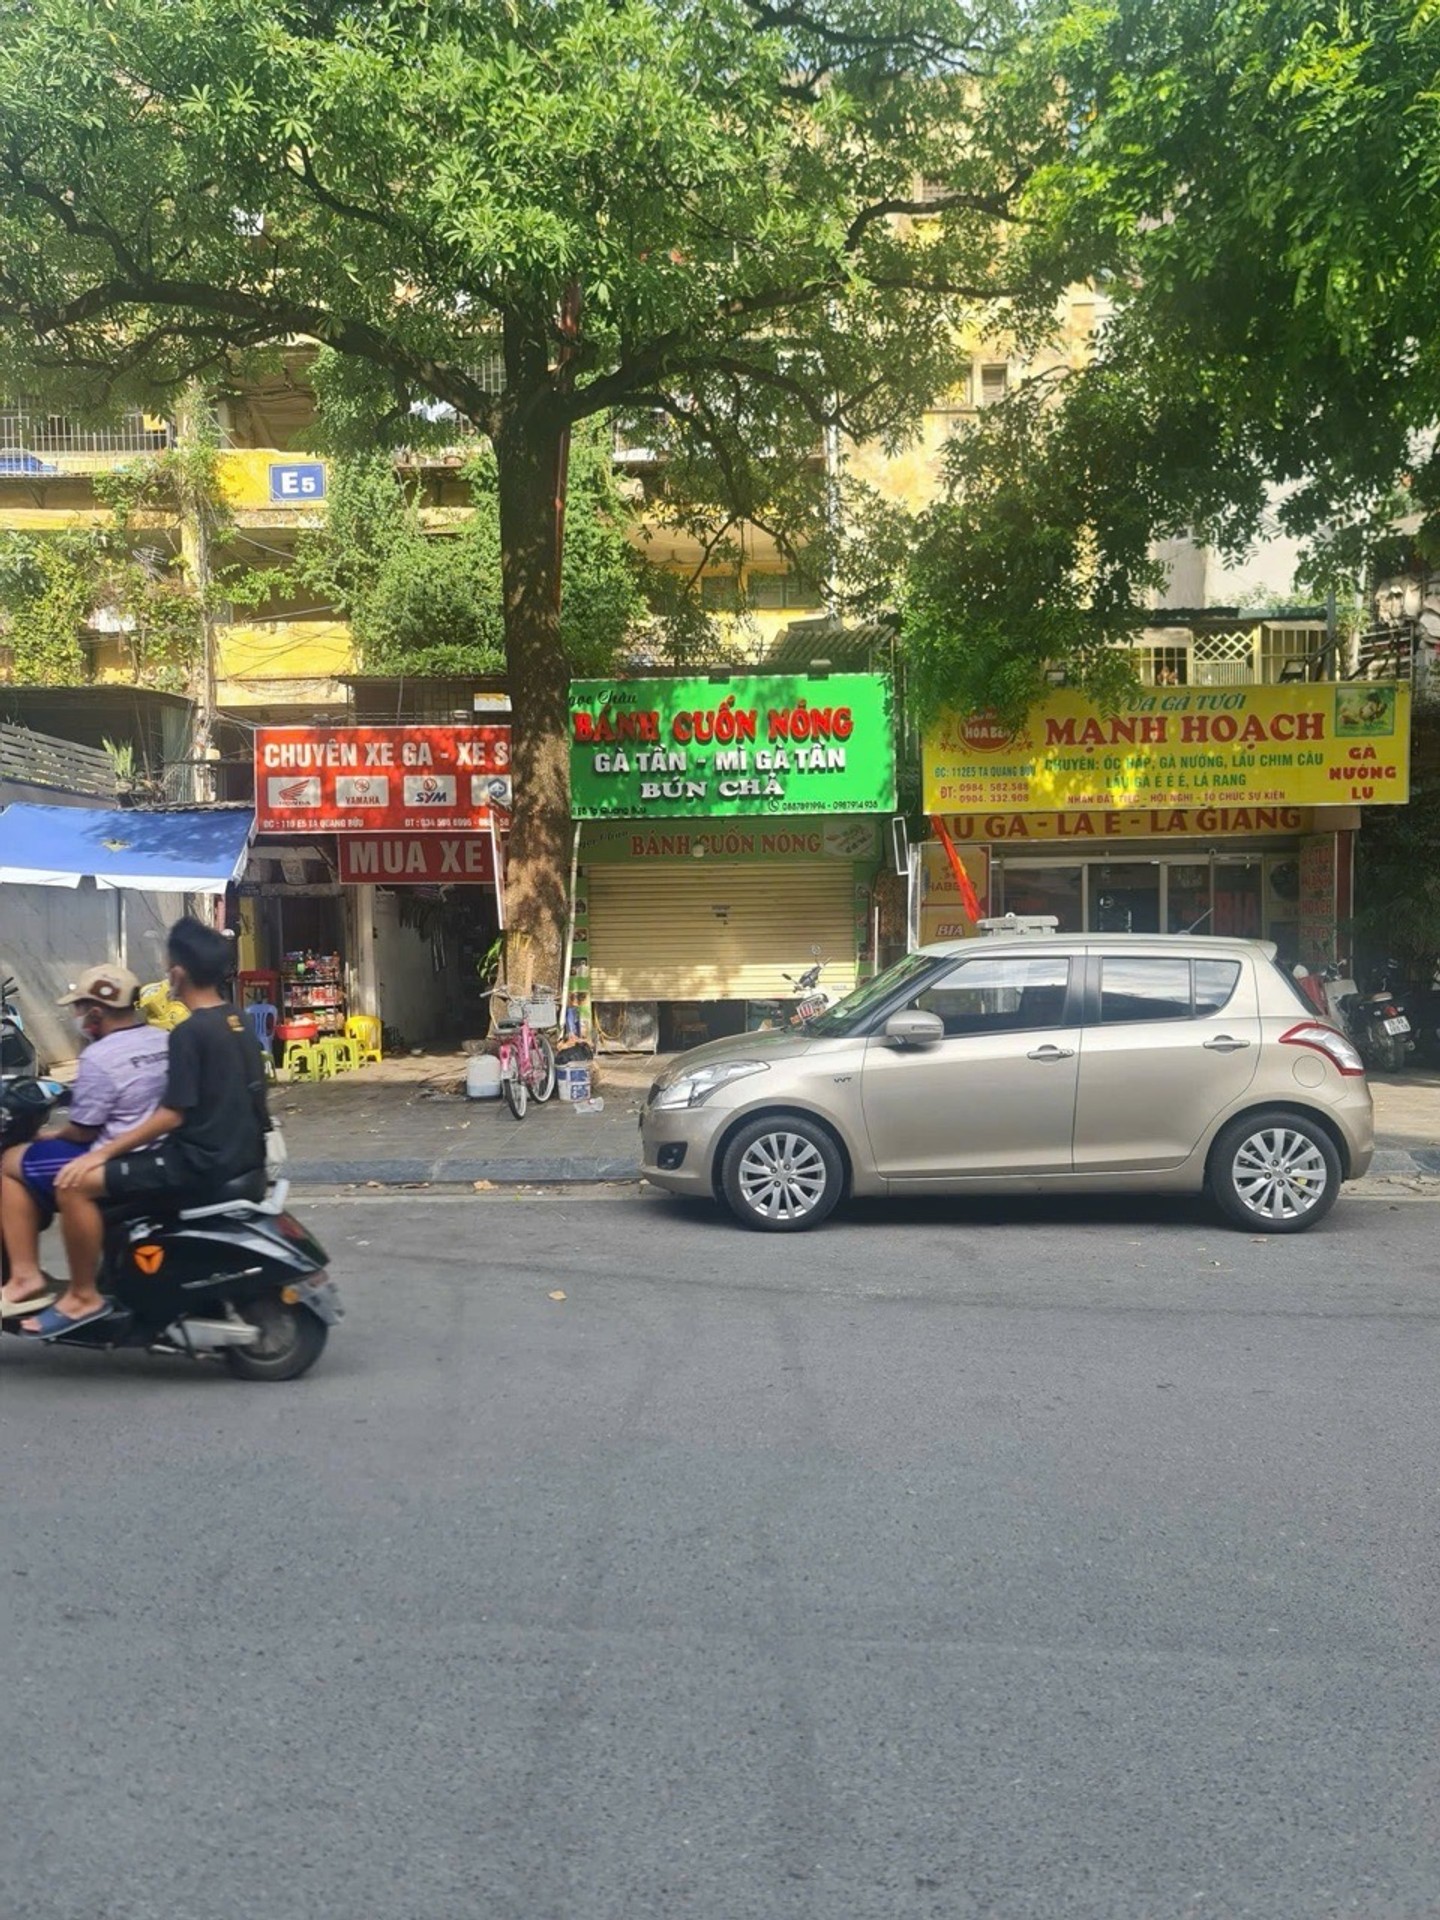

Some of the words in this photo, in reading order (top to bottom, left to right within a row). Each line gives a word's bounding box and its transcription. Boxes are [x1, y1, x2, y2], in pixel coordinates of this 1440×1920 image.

[281, 471, 316, 494] E5
[574, 704, 660, 742] BÁNH
[673, 695, 757, 743] CUỐN
[768, 699, 853, 743] NÓNG
[1045, 716, 1168, 753] MẠNH
[1180, 713, 1325, 750] HOẠCH
[264, 738, 358, 768] CHUYÊN
[365, 742, 394, 766] XE
[402, 742, 433, 766] GA
[595, 747, 630, 773] GÀ
[715, 745, 747, 771] MÌ
[755, 745, 791, 770] GÀ
[1160, 753, 1176, 769] GÀ
[1260, 754, 1292, 767] CHIM
[1348, 744, 1376, 760] GÀ
[1213, 773, 1247, 787] RANG
[1329, 763, 1396, 780] NƯỚNG
[641, 776, 707, 798] BÚN
[719, 772, 784, 797] CHẢ
[1352, 786, 1374, 800] LU
[345, 795, 381, 805] YAMAHA
[415, 792, 447, 803] SYM
[1196, 807, 1300, 832] GIANG
[631, 830, 690, 855] BÁNH
[761, 829, 822, 853] NÓNG
[350, 841, 427, 874] MUA
[440, 840, 483, 873] XE
[936, 923, 965, 937] BIA
